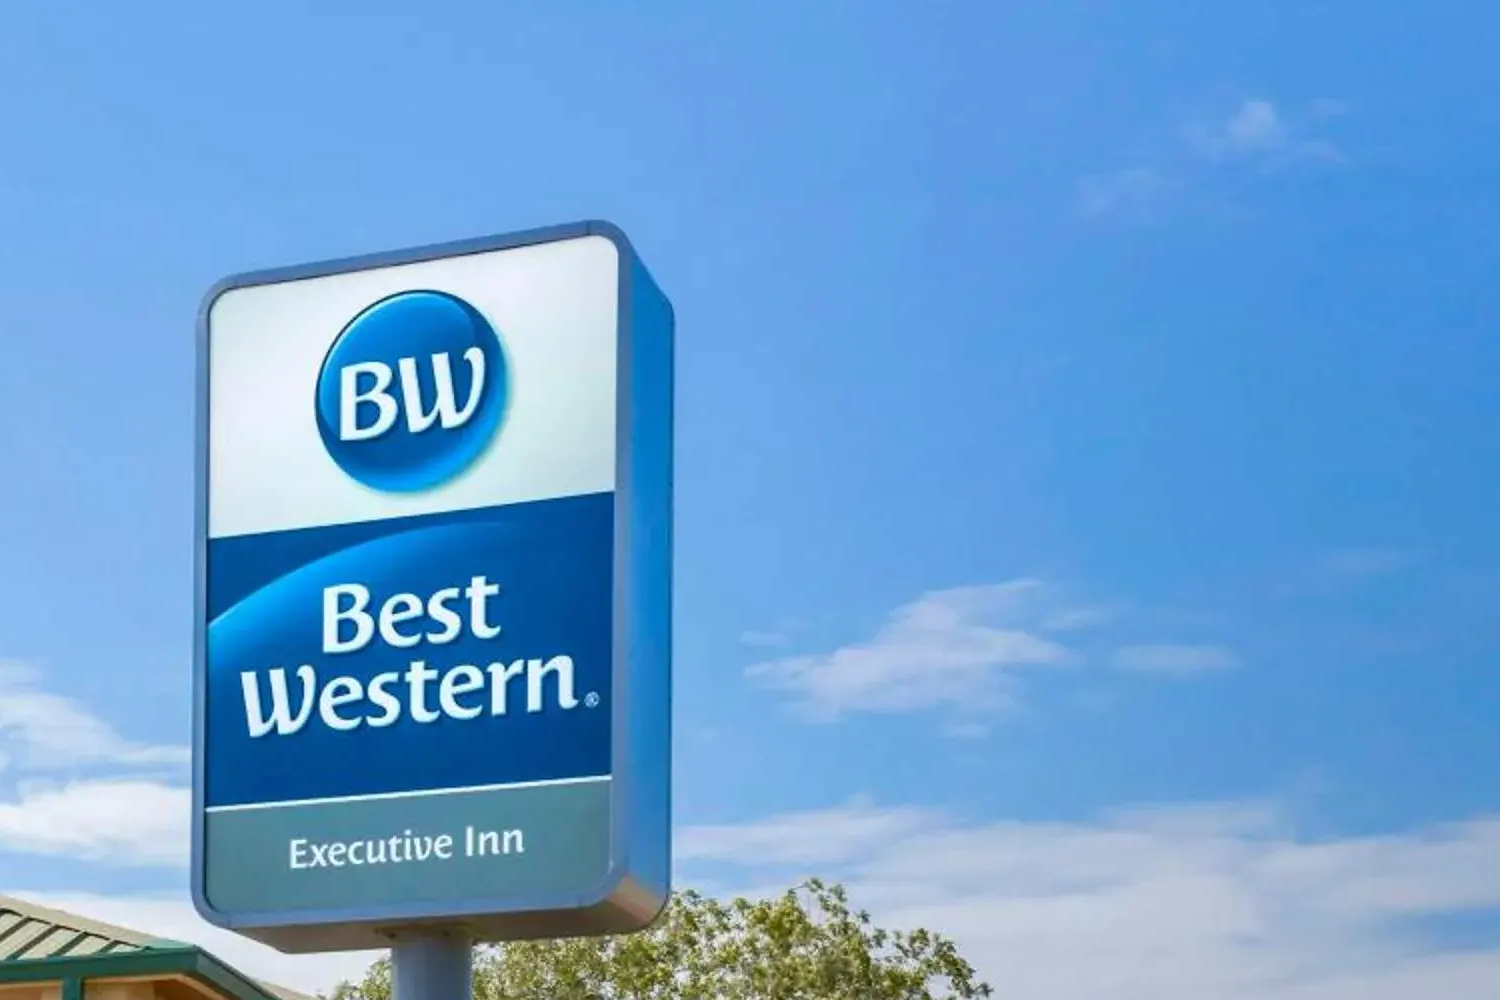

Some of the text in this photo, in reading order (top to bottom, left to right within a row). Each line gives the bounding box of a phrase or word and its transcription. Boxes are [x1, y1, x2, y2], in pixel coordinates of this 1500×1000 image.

[338, 347, 485, 442] BW
[323, 576, 501, 654] Best
[288, 825, 525, 869] Executive Inn
